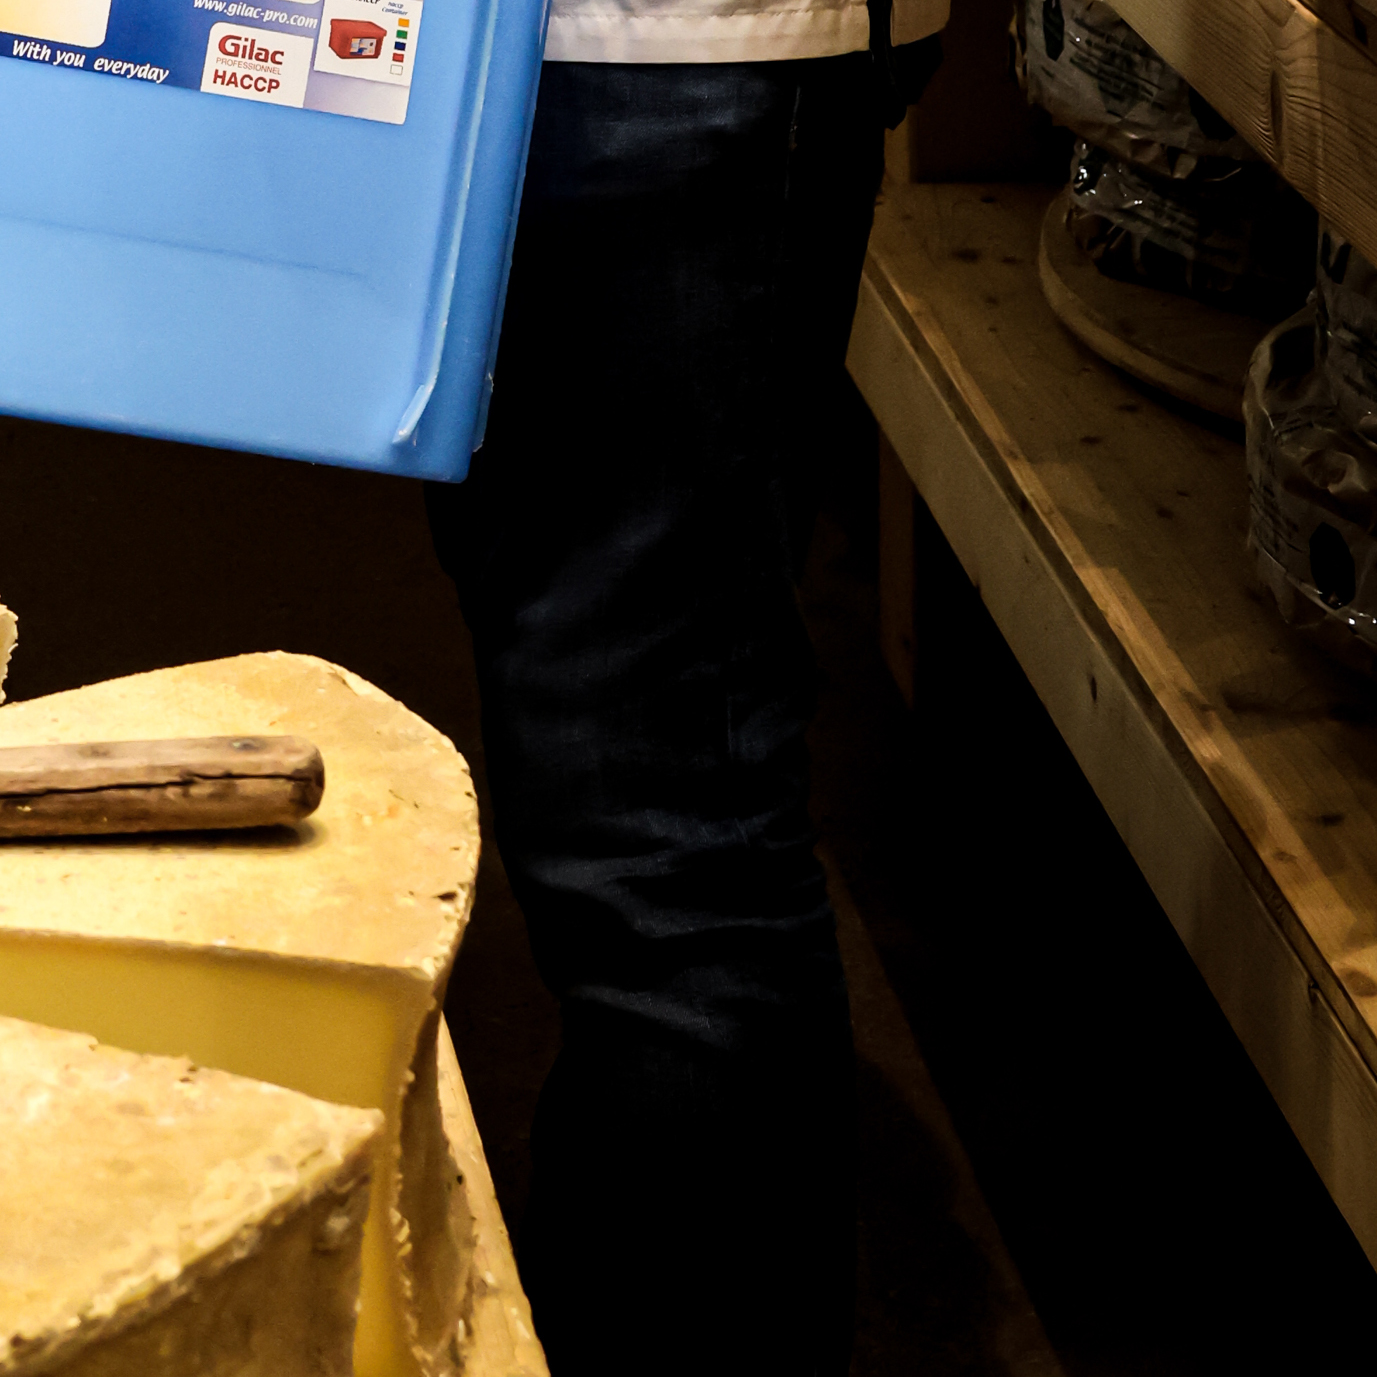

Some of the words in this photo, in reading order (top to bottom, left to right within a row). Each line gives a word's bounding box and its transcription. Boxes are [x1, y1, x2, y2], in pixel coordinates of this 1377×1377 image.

[12, 39, 51, 62] With
[52, 50, 86, 68] you
[93, 57, 170, 84] everyday
[218, 34, 284, 65] Gilac
[212, 68, 280, 94] HACCP
[215, 57, 282, 85] PROFESSIONNEL
